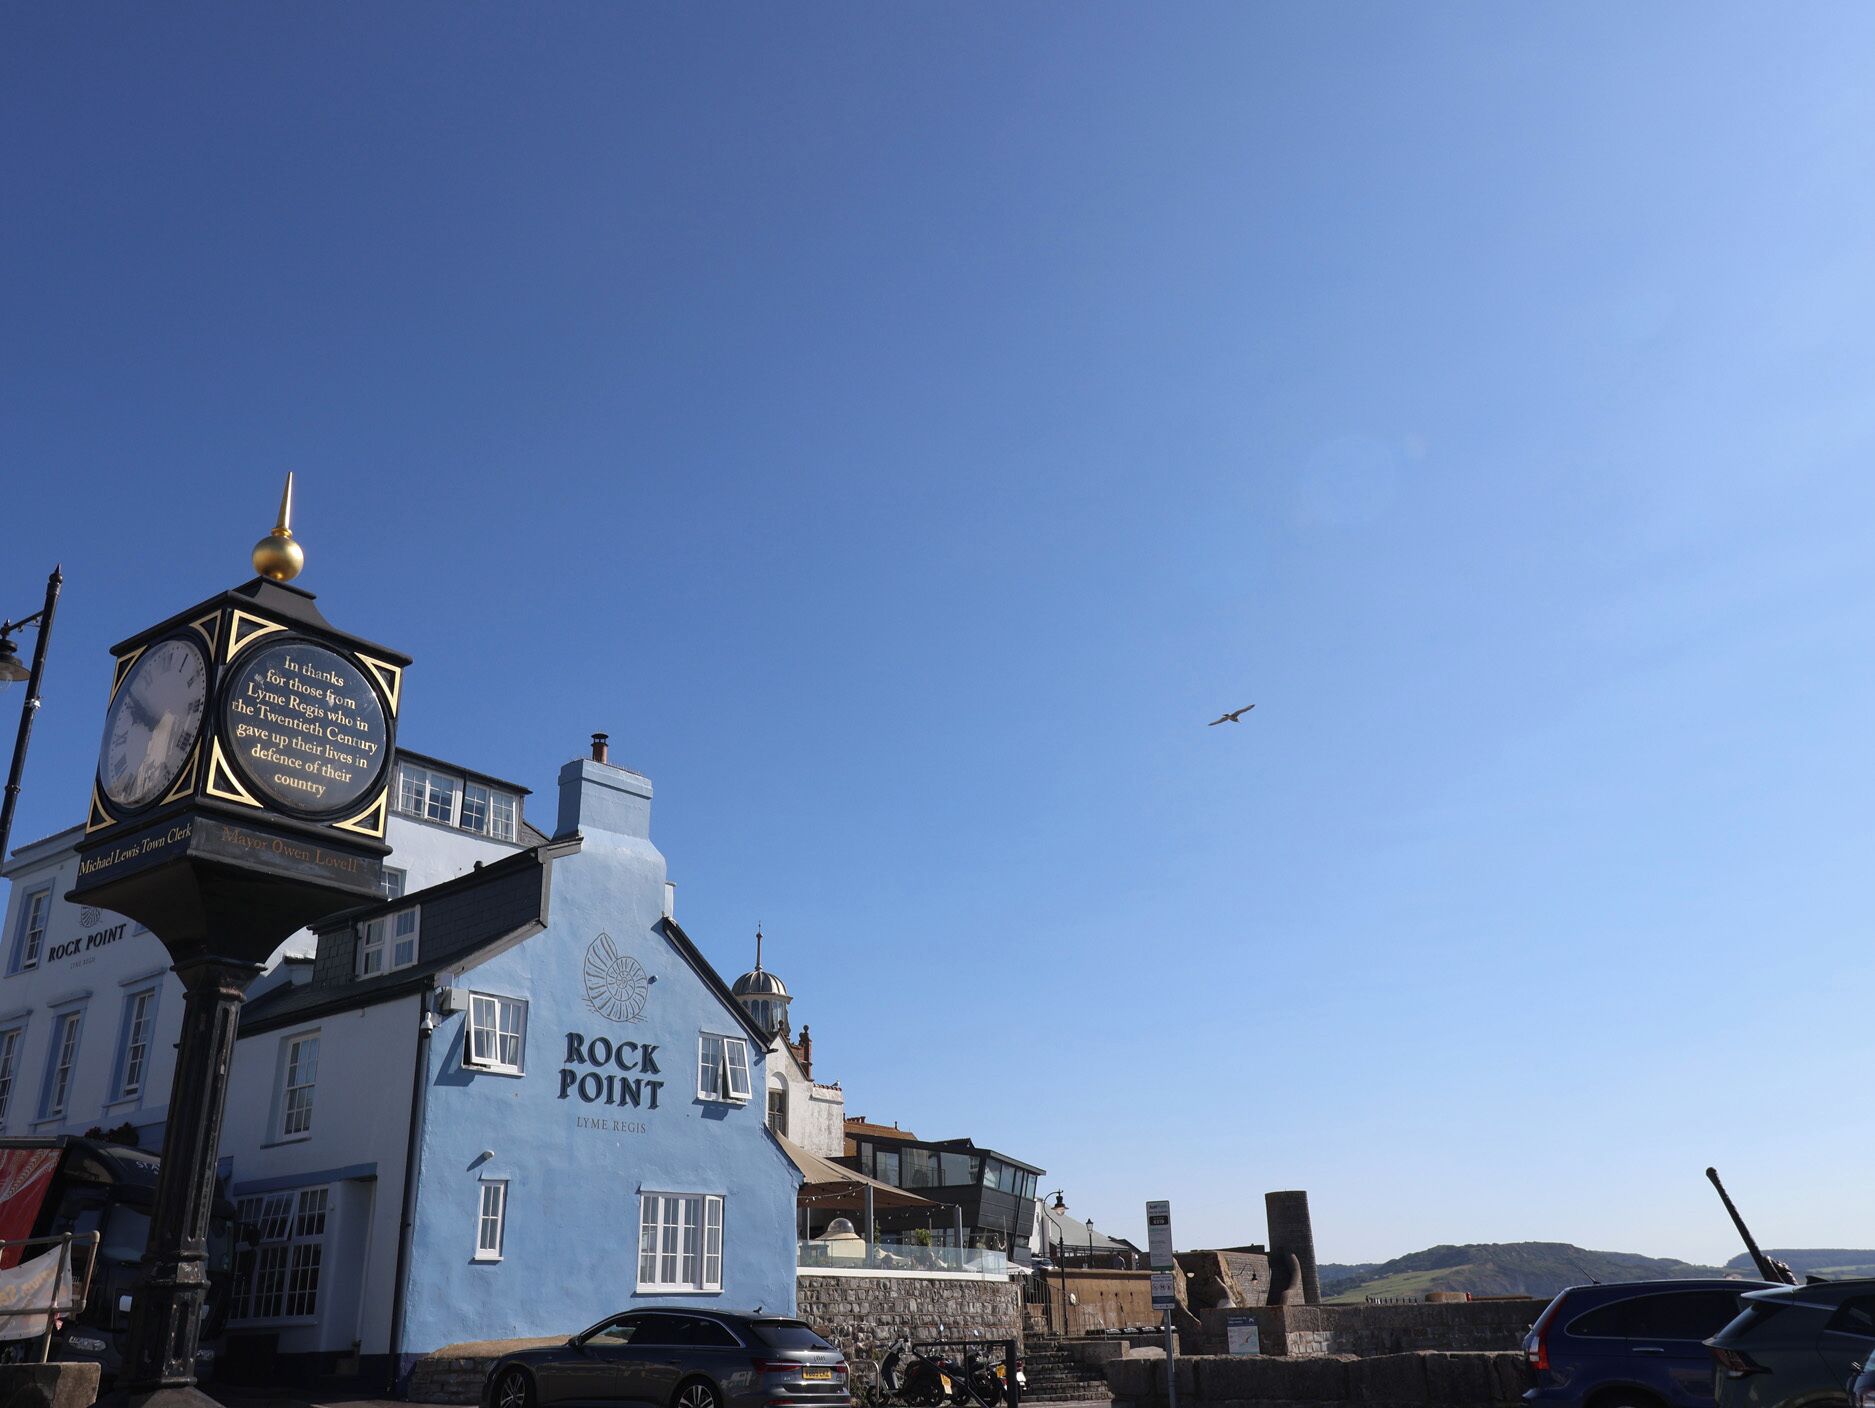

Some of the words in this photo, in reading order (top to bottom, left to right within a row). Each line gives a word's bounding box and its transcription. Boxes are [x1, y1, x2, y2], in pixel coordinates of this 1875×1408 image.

[266, 669, 287, 686] for
[289, 678, 323, 698] those
[326, 689, 356, 709] from
[283, 656, 299, 673] In
[302, 663, 344, 687] thanks
[232, 699, 255, 715] the
[257, 703, 323, 736] Twentieth
[326, 726, 378, 755] Century
[247, 682, 286, 705] Lyme
[289, 695, 325, 719] Regis
[327, 711, 353, 727] who
[356, 717, 369, 732] in
[236, 723, 269, 740] gave
[271, 733, 289, 749] up
[292, 737, 323, 756] their
[325, 745, 353, 764] lives
[355, 754, 368, 768] in
[251, 744, 302, 769] defence
[305, 761, 321, 774] of
[321, 764, 352, 783] their
[274, 773, 326, 798] country
[79, 851, 114, 876] Michael
[114, 844, 140, 864] Lewis
[141, 837, 166, 854] Town
[167, 823, 192, 844] Clerk
[223, 824, 268, 849] Mayor
[272, 839, 310, 862] Owen
[316, 848, 357, 873] Lovell
[48, 938, 82, 963] ROCK
[85, 923, 127, 950] POINT
[564, 1032, 661, 1075] ROCK
[557, 1068, 664, 1110] POINT
[576, 1116, 608, 1130] LYME
[613, 1120, 646, 1134] REGIS
